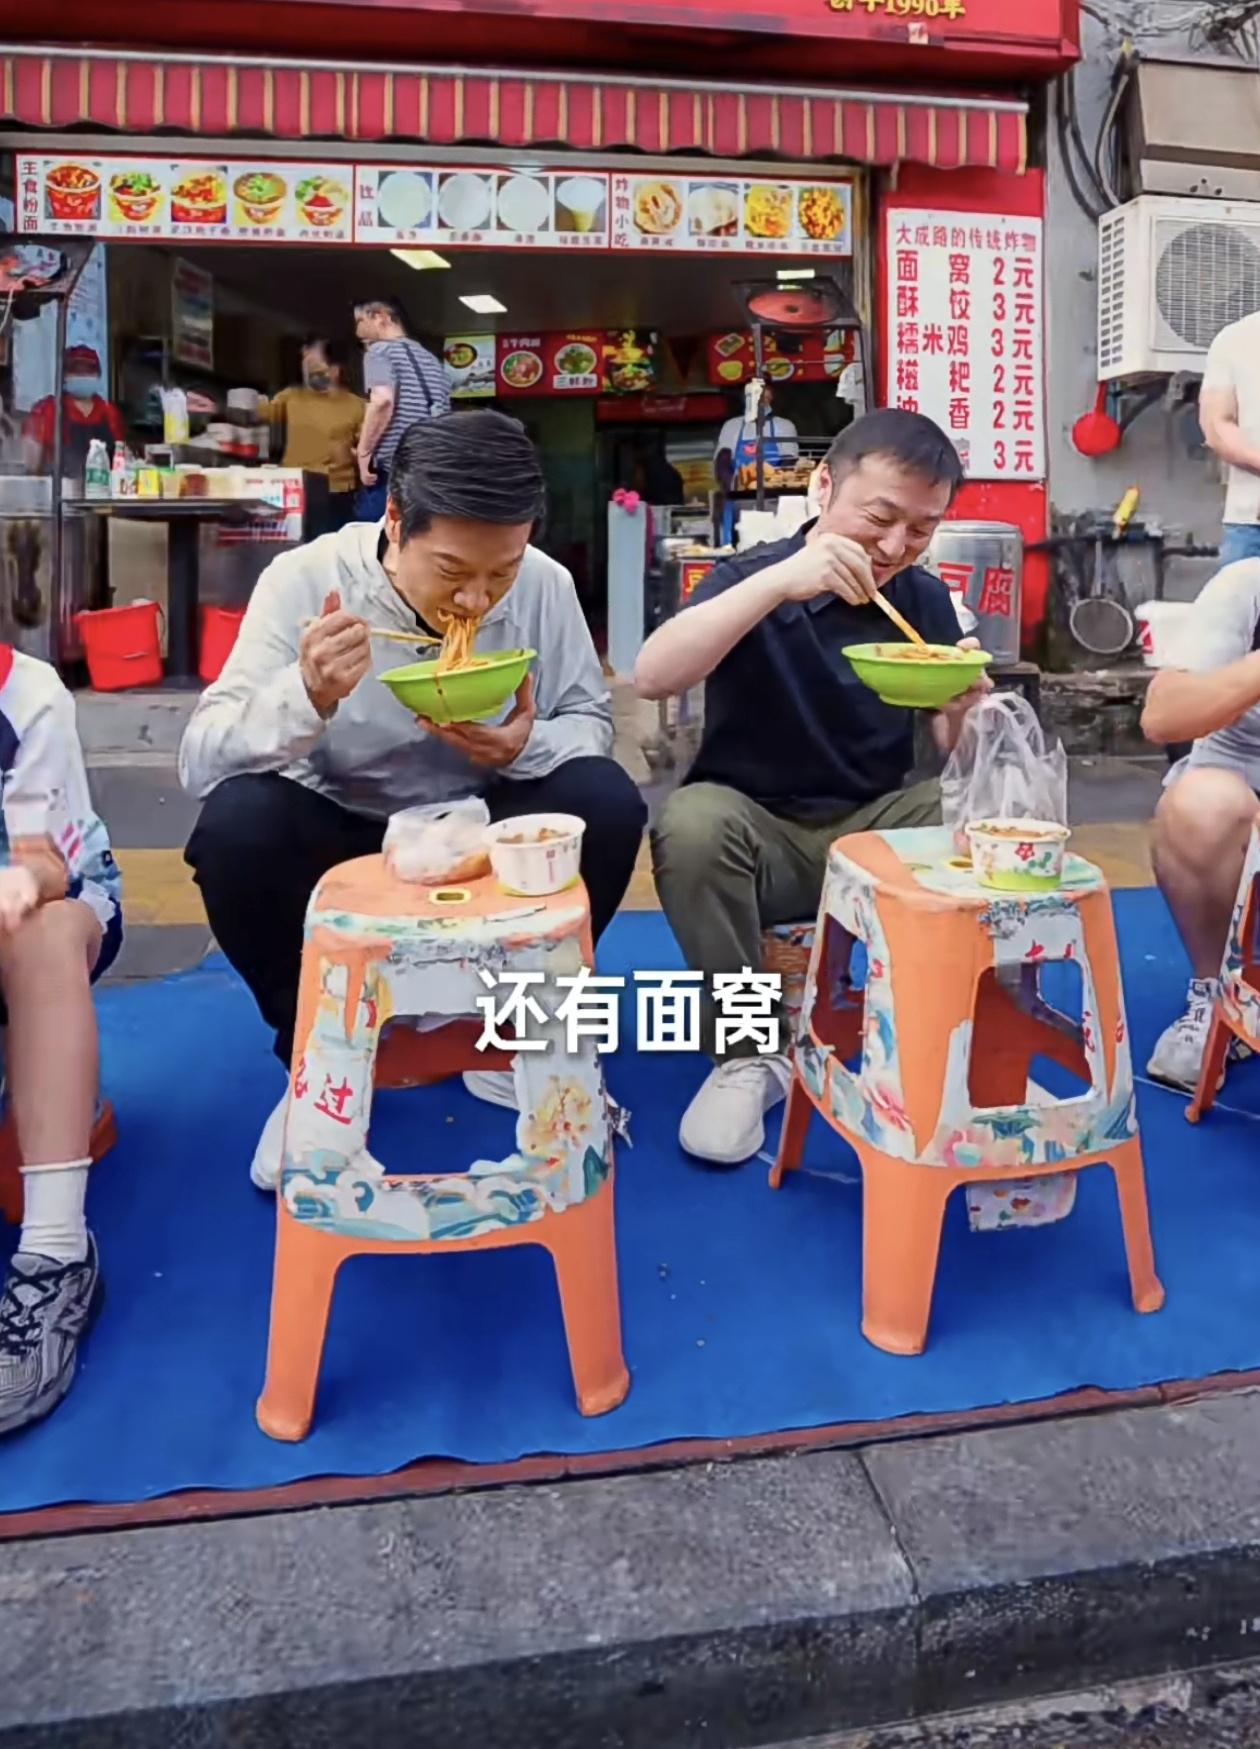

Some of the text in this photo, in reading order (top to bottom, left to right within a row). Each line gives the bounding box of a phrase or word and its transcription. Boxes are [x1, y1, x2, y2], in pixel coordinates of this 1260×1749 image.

[614, 177, 630, 247] 炸物小吃
[895, 222, 1037, 252] 大成路的传统炸物
[992, 256, 1035, 288] 2元
[992, 292, 1036, 325] 3元
[896, 322, 1034, 361] 糯米鸡 3元
[993, 363, 1035, 396] 2元
[992, 400, 1035, 431] 2元
[993, 440, 1035, 473] 3元
